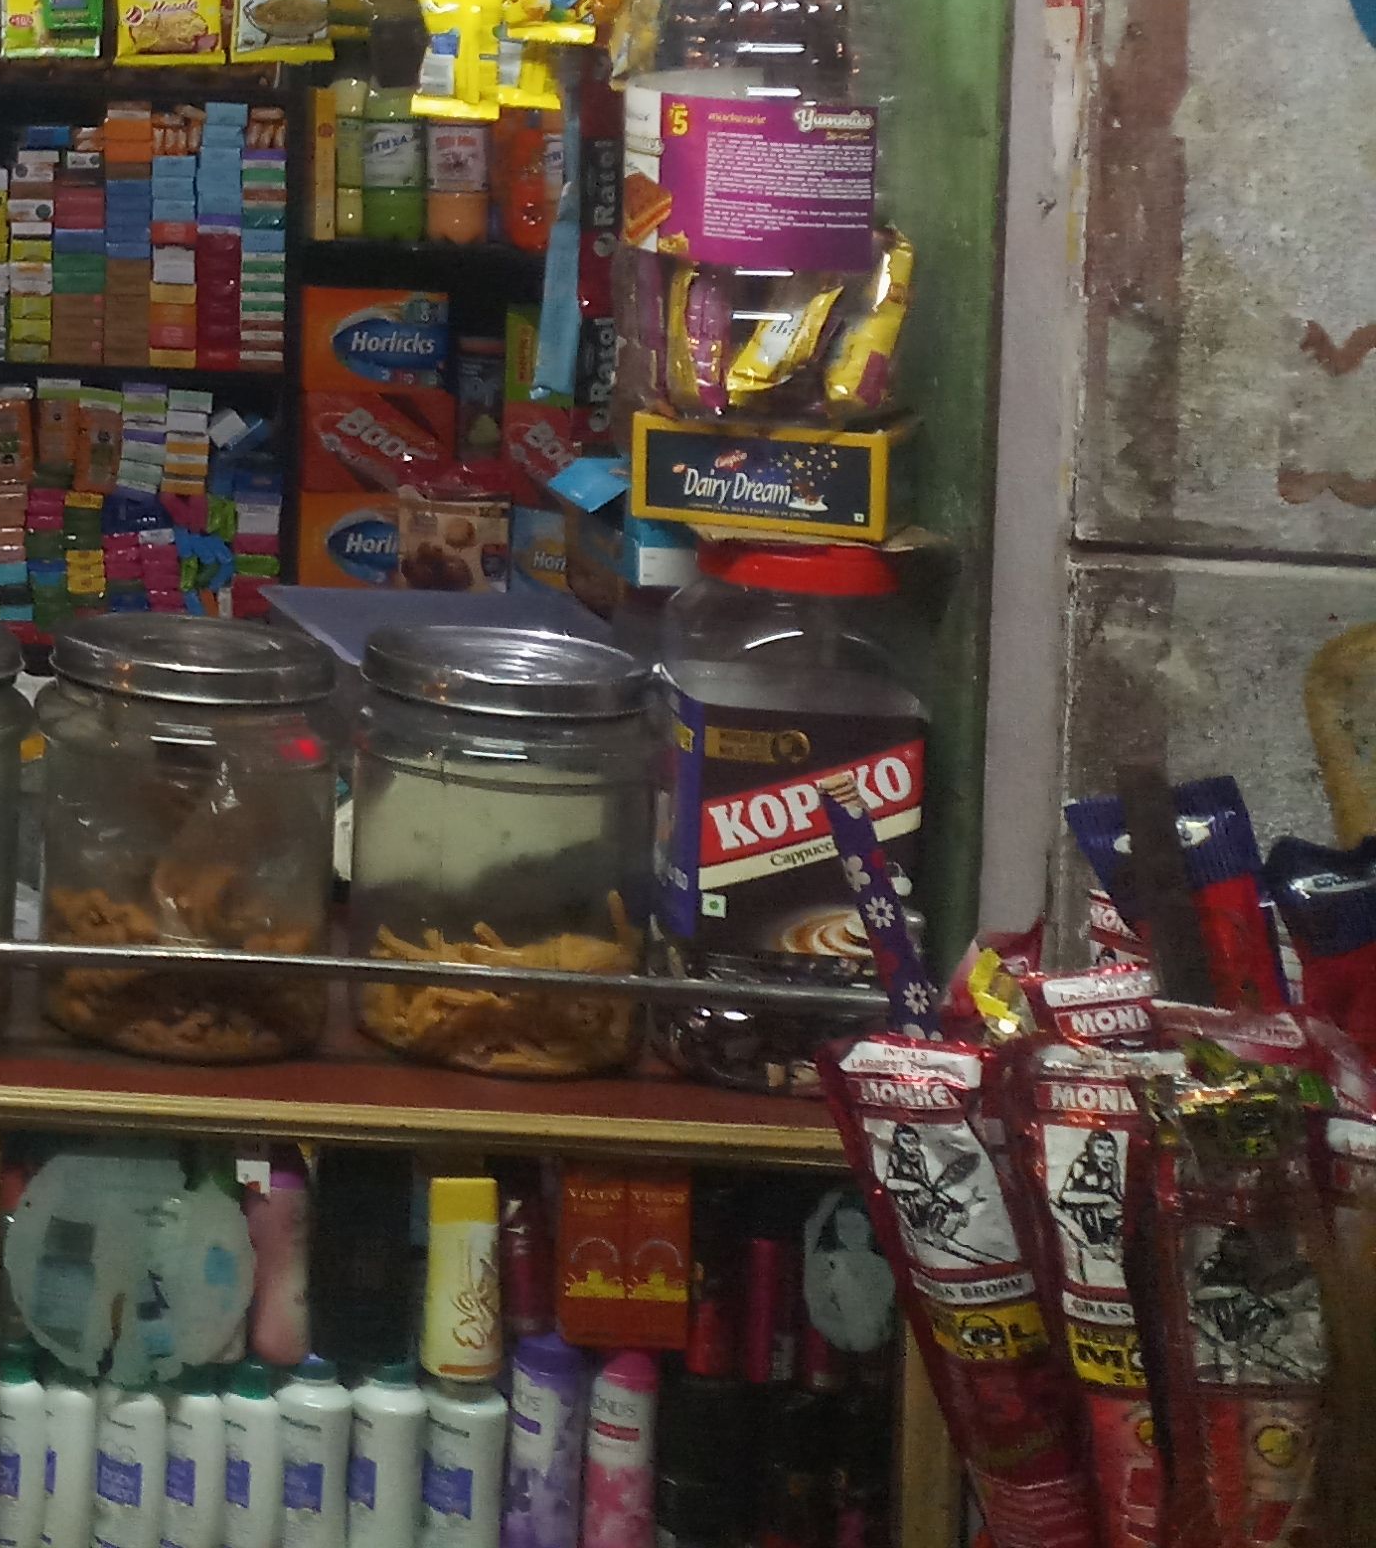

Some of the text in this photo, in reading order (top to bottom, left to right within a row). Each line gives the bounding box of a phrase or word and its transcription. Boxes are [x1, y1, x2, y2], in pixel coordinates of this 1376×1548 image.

[795, 107, 875, 133] Yummies
[351, 330, 436, 355] Horlicks
[683, 466, 792, 505] Dairy Dream
[708, 756, 913, 851] KOPKO
[769, 840, 836, 868] Cappucc
